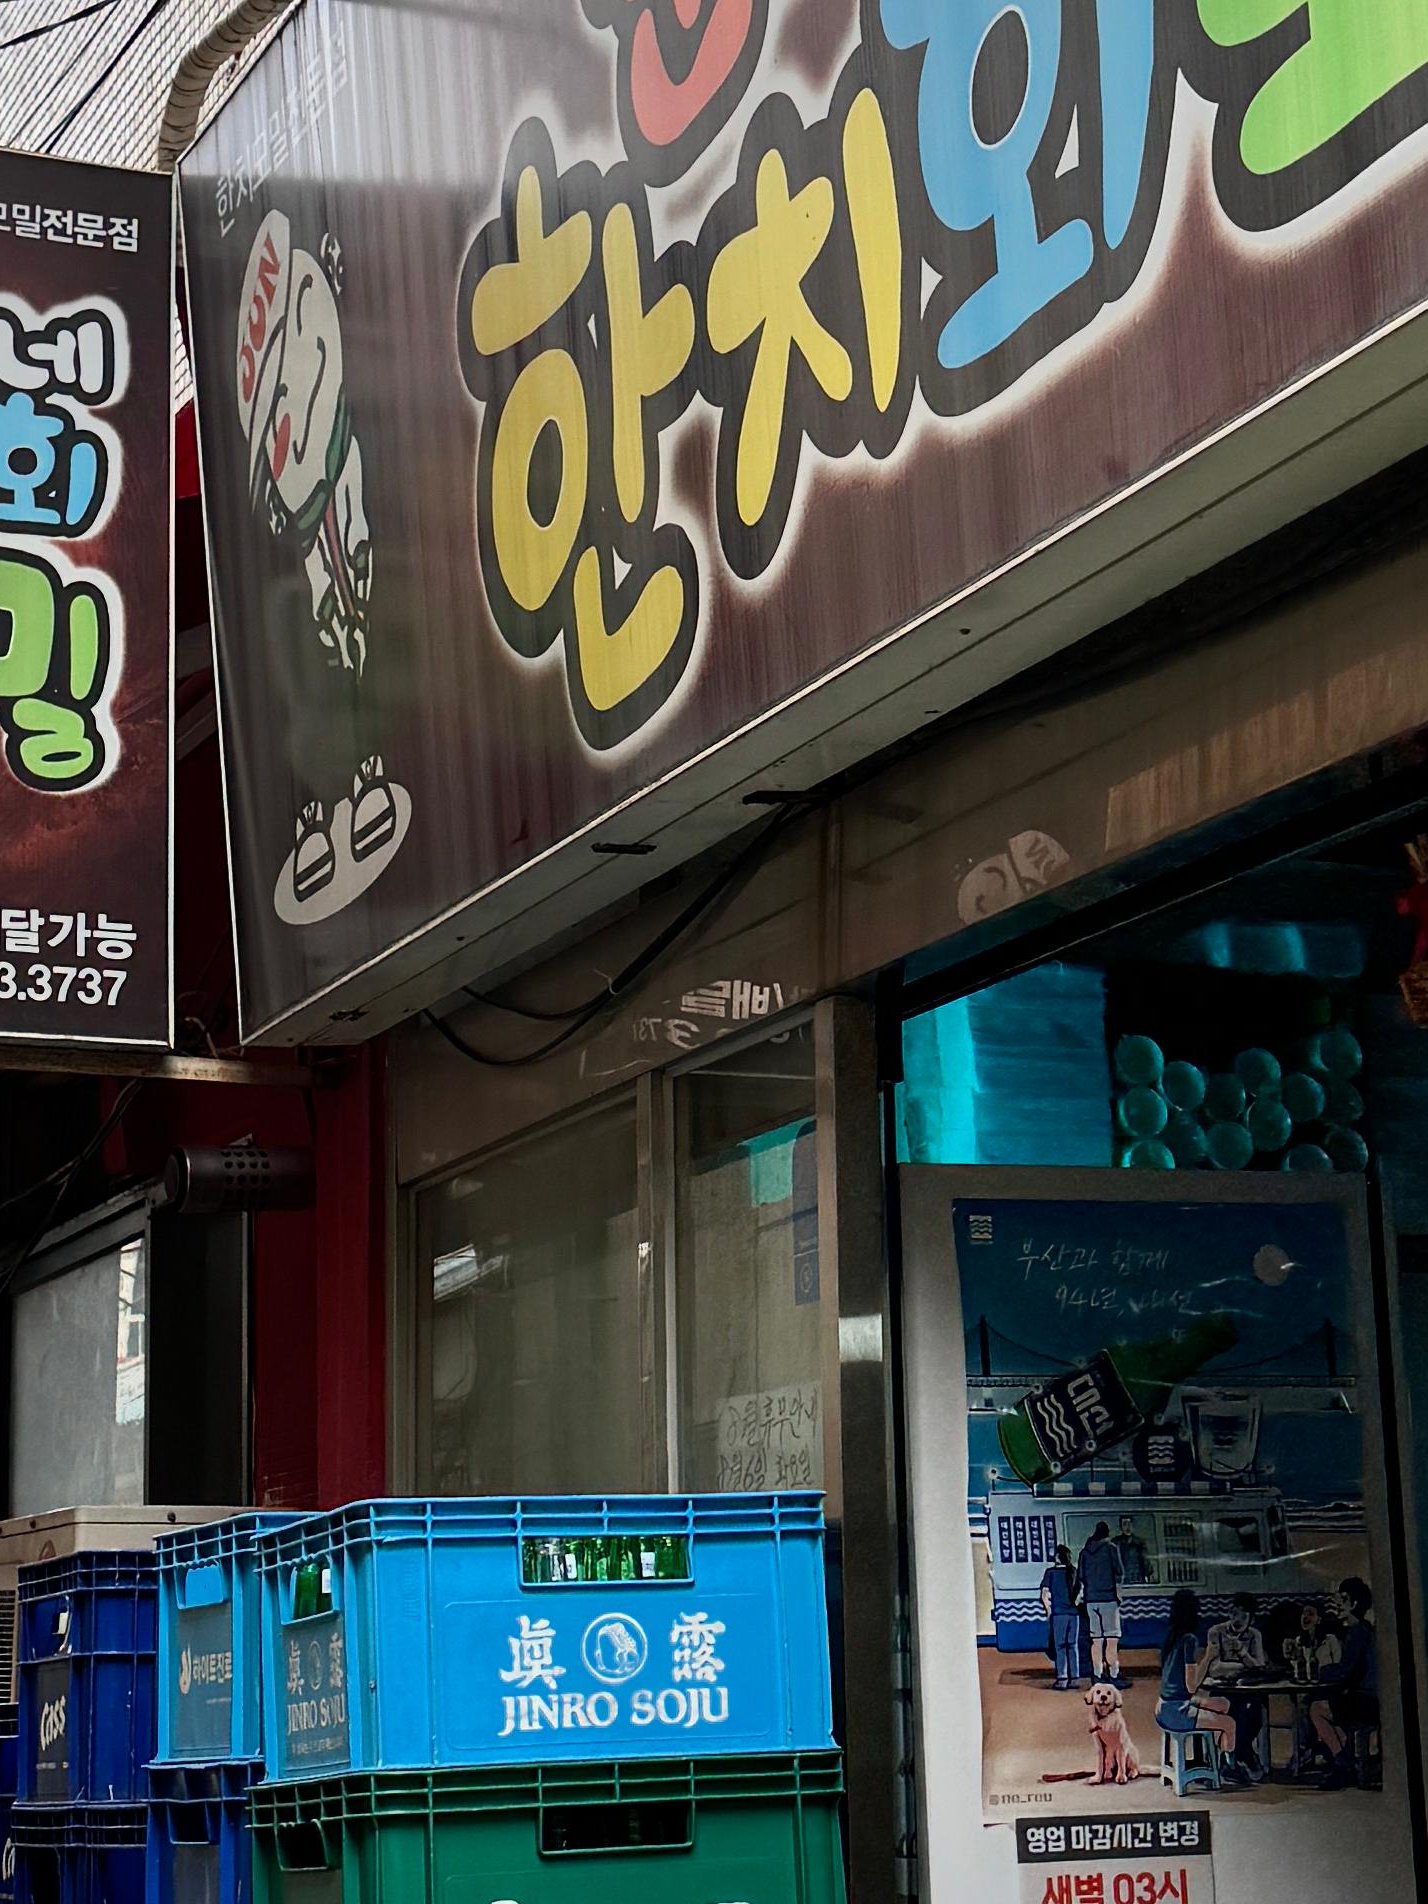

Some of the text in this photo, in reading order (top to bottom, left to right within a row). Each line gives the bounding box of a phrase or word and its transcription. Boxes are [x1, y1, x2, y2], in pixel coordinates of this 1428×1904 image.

[239, 232, 282, 403] JUN
[497, 1686, 730, 1737] JINRO SOJU
[1025, 1820, 1200, 1853] 영업 마감시간 변경
